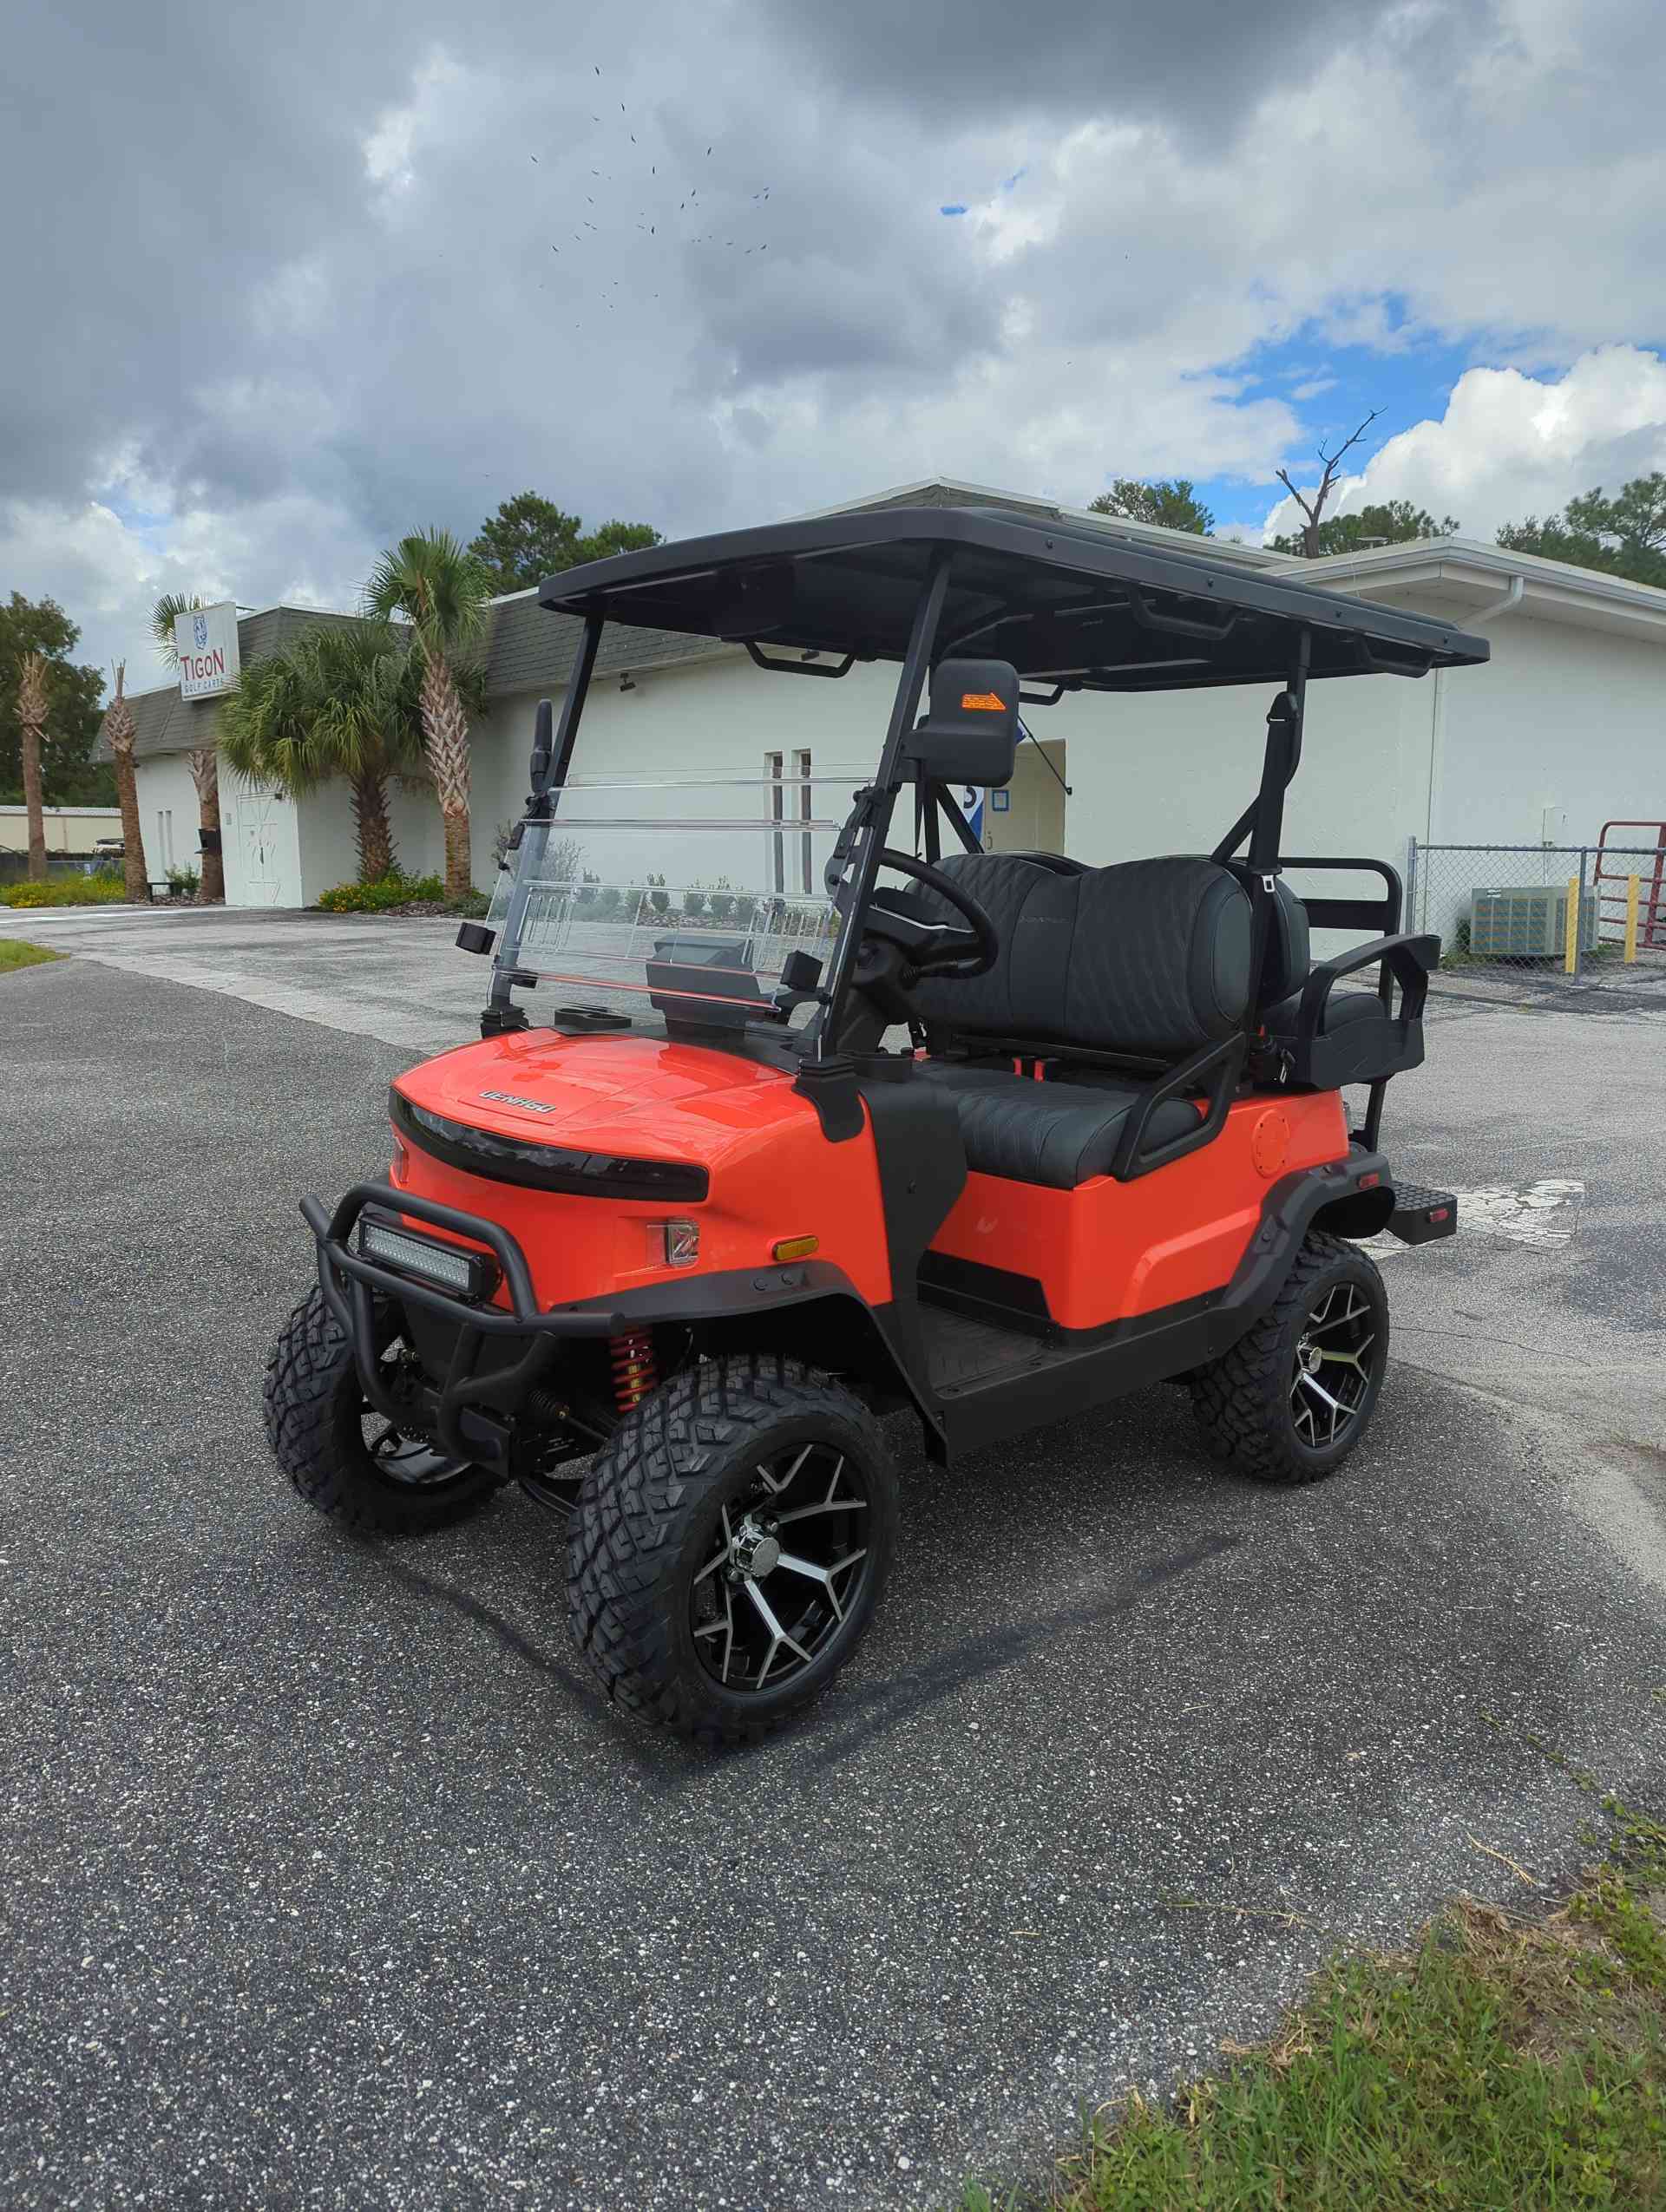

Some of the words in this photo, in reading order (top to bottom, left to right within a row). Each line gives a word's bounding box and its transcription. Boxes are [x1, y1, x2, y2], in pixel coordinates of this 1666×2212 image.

[180, 648, 225, 680] TIGON
[185, 682, 201, 693] GOLF
[478, 1090, 557, 1114] DENAGO
